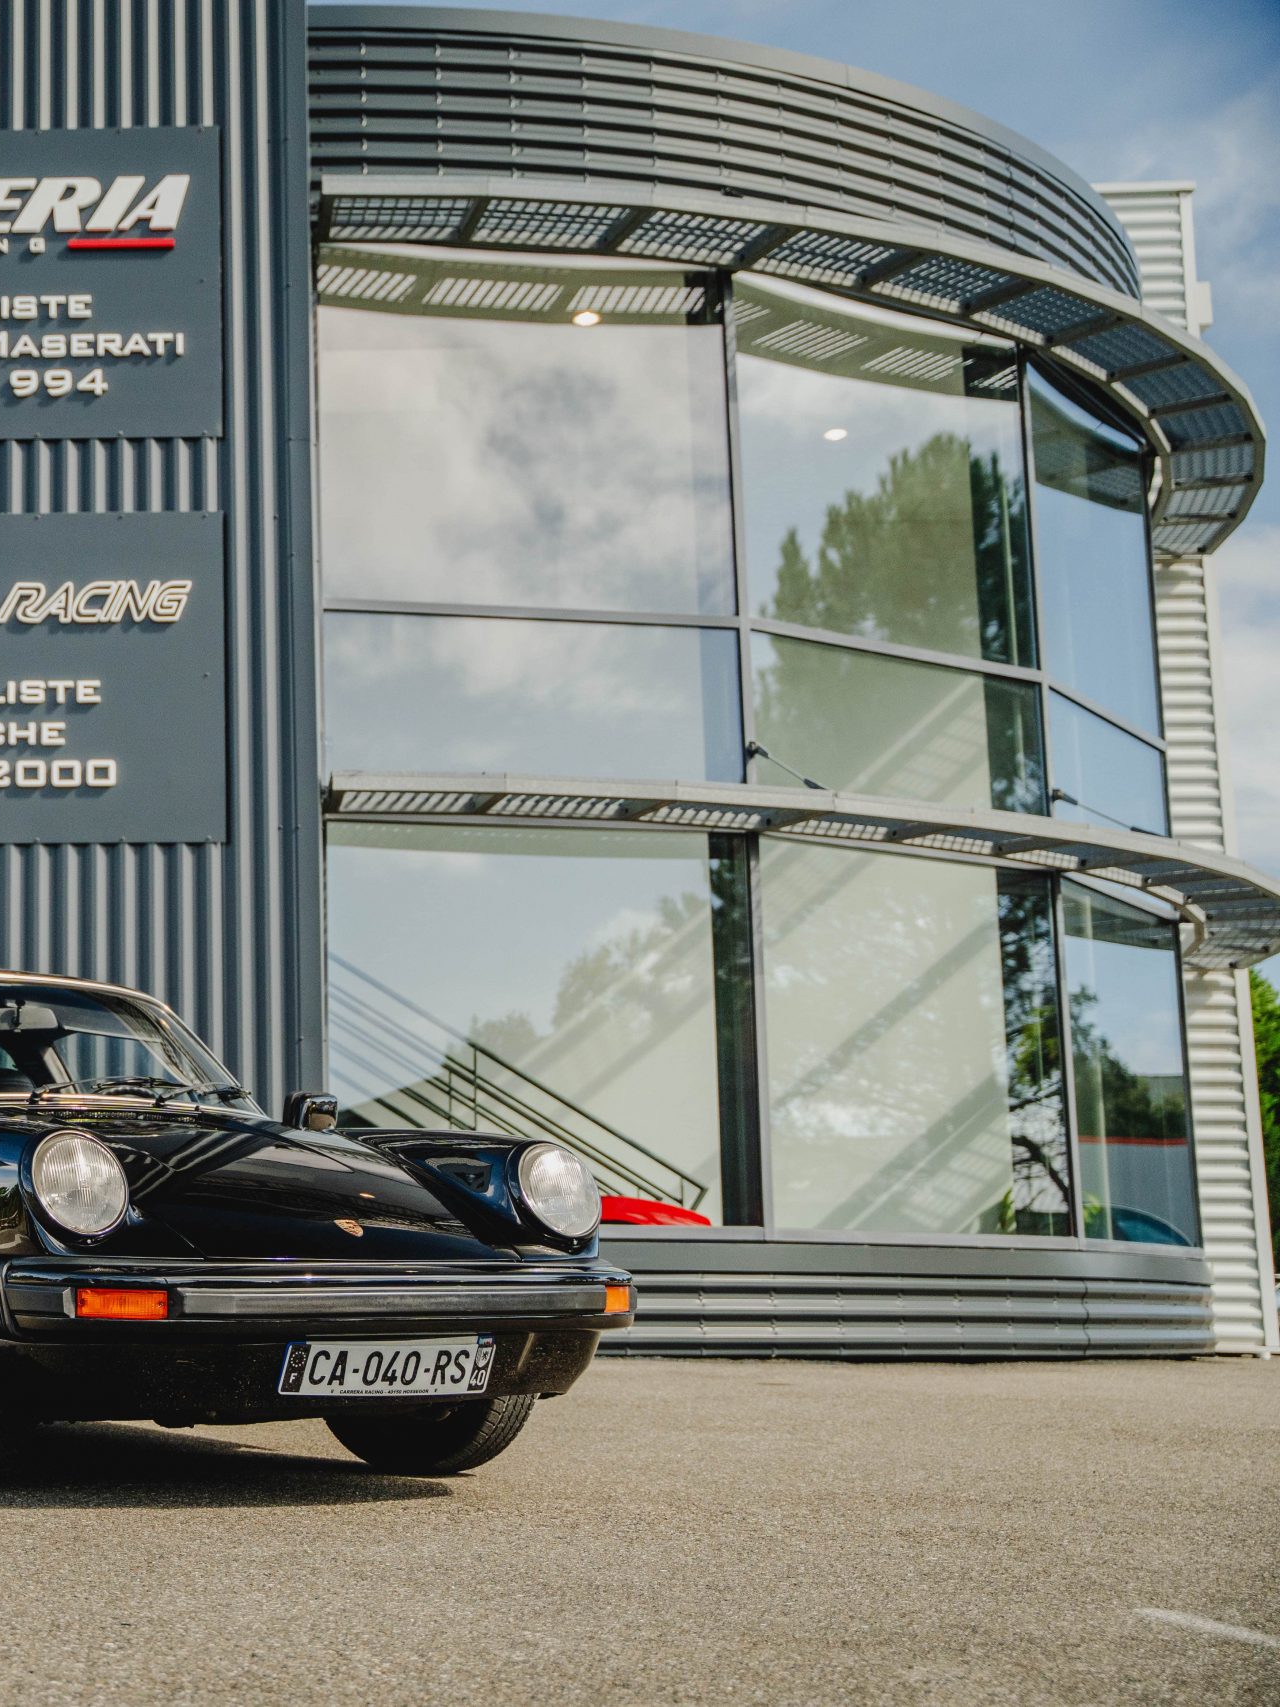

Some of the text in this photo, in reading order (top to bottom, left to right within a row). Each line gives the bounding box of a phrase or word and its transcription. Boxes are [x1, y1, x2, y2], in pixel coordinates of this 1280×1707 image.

[308, 1349, 471, 1386] CA-040-RS
[289, 1372, 298, 1384] F
[470, 1369, 486, 1387] 40
